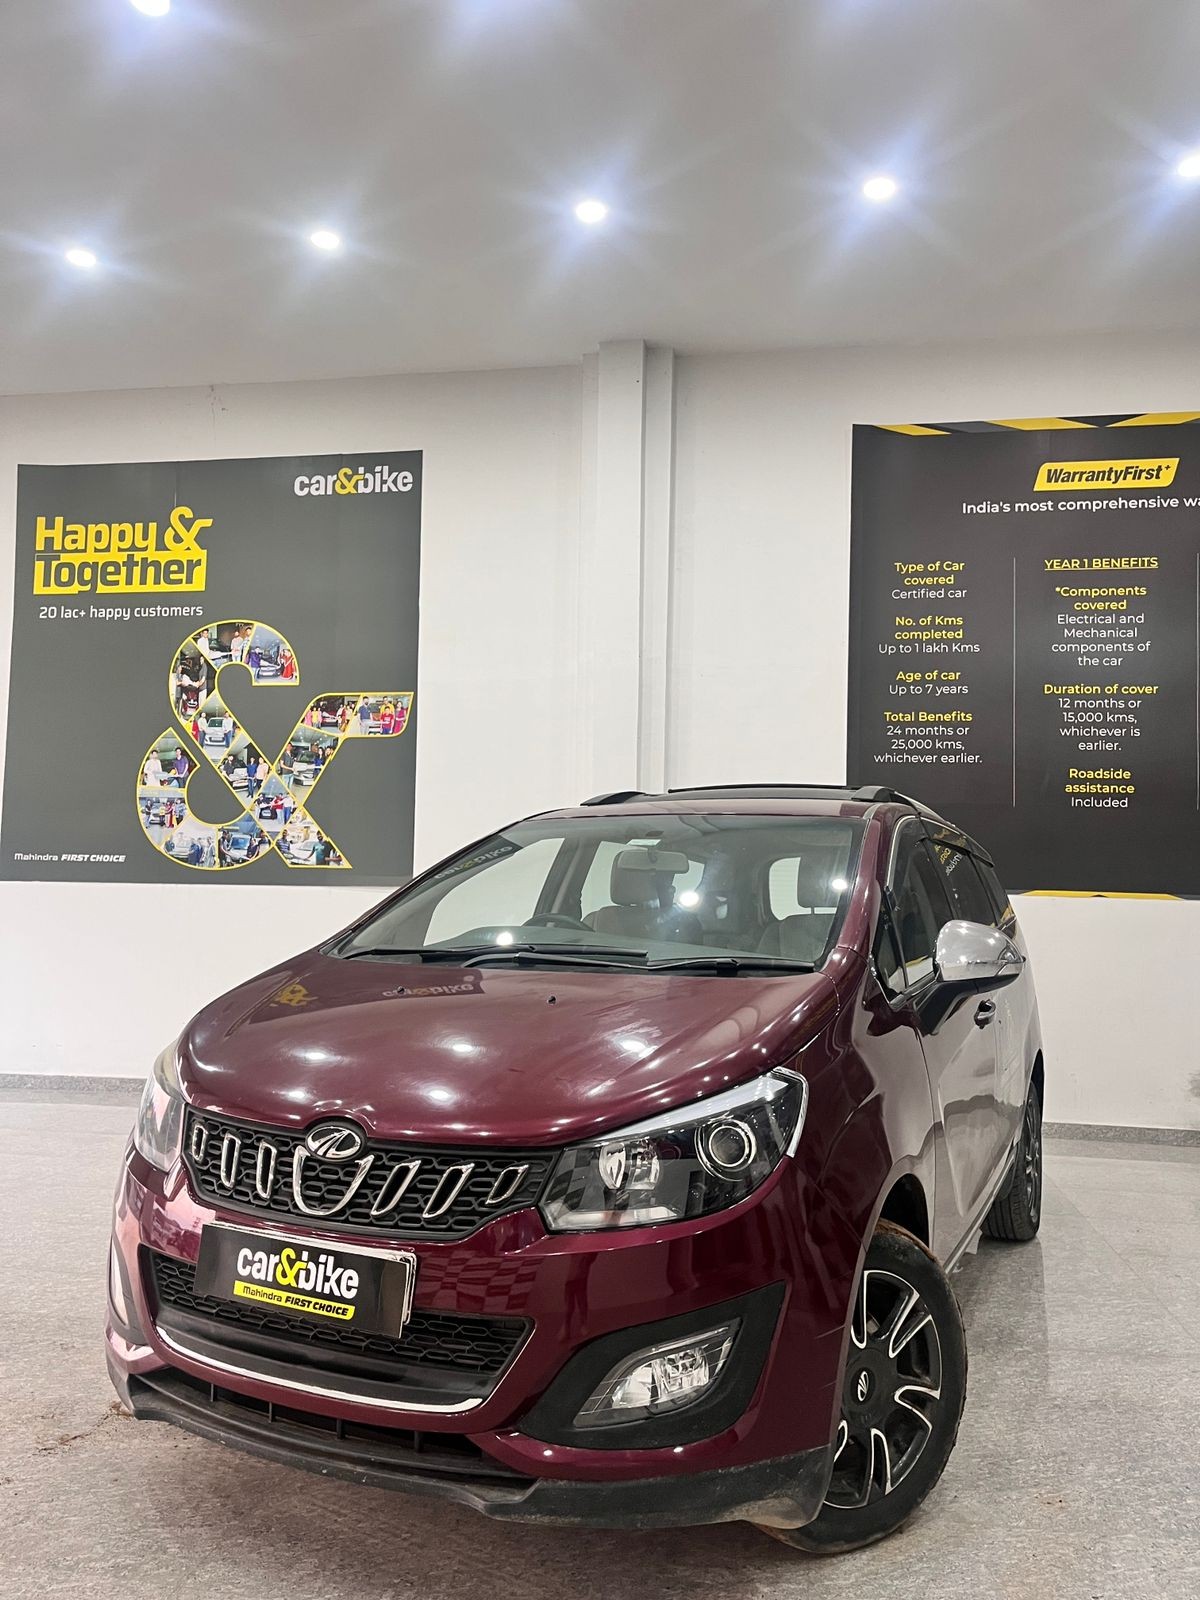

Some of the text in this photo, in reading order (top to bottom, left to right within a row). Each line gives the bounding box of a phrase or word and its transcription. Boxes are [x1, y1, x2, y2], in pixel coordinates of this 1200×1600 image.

[293, 465, 414, 497] car&bike
[962, 496, 1200, 514] India's most comprehensive w
[35, 505, 214, 552] Happy &
[894, 561, 966, 574] Type of Car
[1044, 557, 1159, 569] YEAR 1 BENEFITS
[36, 553, 202, 593] Together
[904, 574, 955, 585] covered
[891, 588, 967, 599] Certified car
[1073, 599, 1127, 610] covered
[39, 605, 203, 621] 20 lac+ happy customers
[1057, 613, 1145, 624] Electrical and
[895, 615, 964, 626] No. of Kms
[894, 628, 963, 641] completed
[1064, 627, 1138, 638] Mechanical
[878, 642, 981, 655] Up to 1 lakh Kms
[1051, 640, 1151, 653] components of
[1077, 655, 1123, 666] the car
[896, 670, 961, 682] Age of car
[889, 684, 969, 696] Up to 7 years
[1043, 683, 1158, 694] Duration of cover
[1058, 698, 1142, 708] 12 months or
[884, 710, 973, 721] Total Benefits
[1062, 712, 1138, 724] 15,000 kms,
[886, 725, 970, 735] 24 months or
[1059, 726, 1141, 736] whichever is
[891, 739, 965, 751] 25,000 kms,
[1078, 740, 1122, 750] earlier.
[873, 752, 983, 763] whichever earlier.
[1069, 768, 1132, 779] Roadside
[1064, 782, 1136, 793] assistance
[1071, 796, 1129, 808] Included
[14, 853, 126, 862] Mahindra FIRST CHOICE
[236, 1247, 360, 1299] car&bike
[242, 1285, 349, 1316] Mahindra FIRST CHOICE
